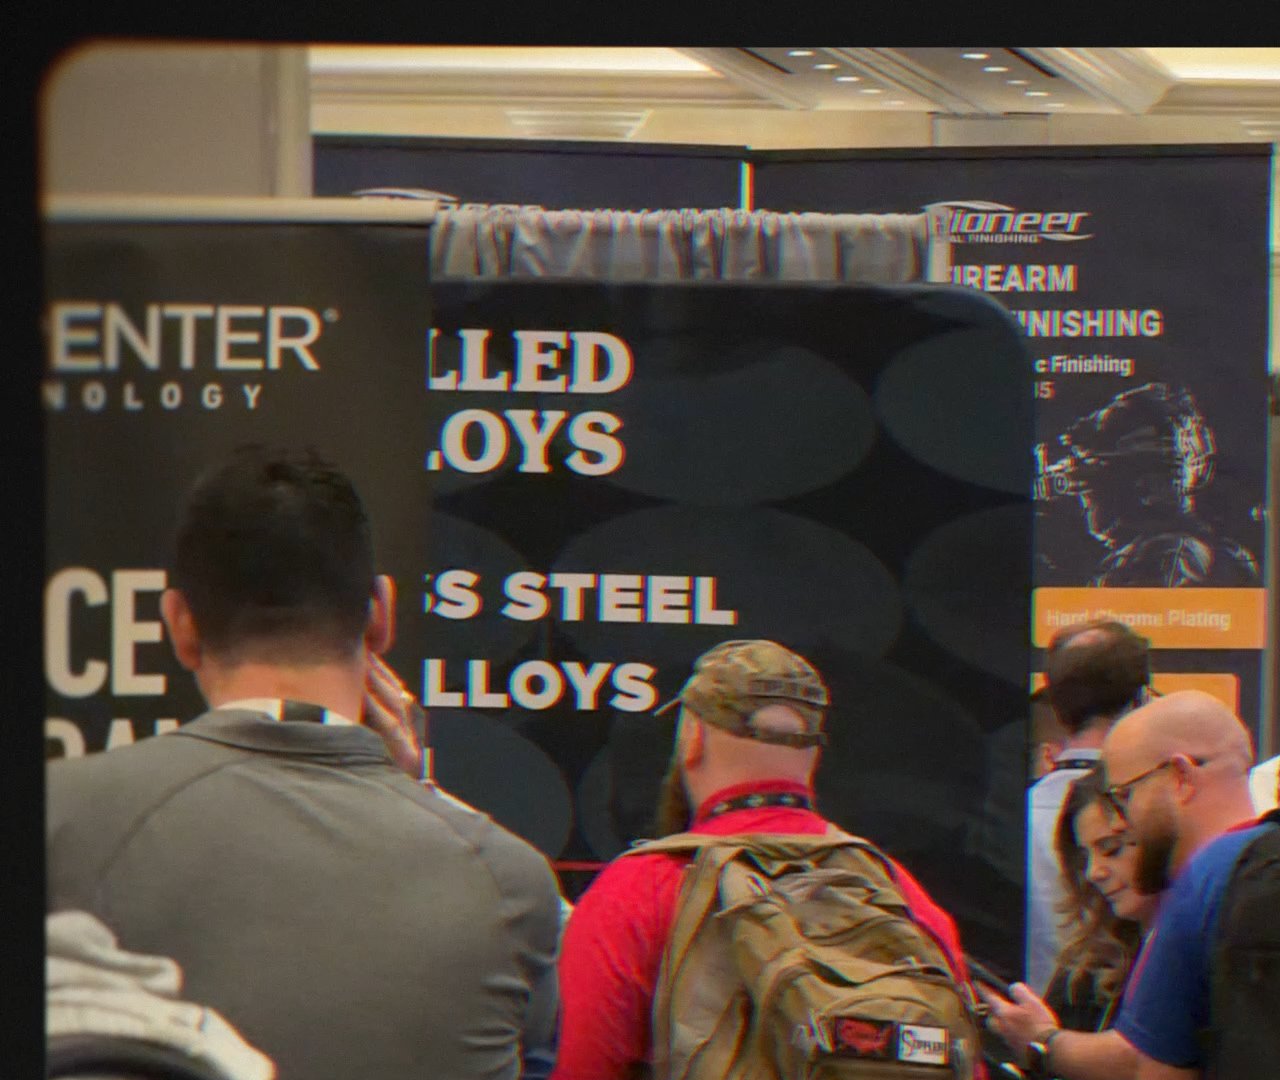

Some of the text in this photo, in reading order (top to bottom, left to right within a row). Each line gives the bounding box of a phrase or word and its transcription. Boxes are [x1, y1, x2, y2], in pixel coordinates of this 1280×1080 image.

[950, 209, 1091, 233] ioneer
[950, 264, 1078, 292] IREARM
[1050, 354, 1135, 377] Finishing
[426, 408, 627, 477] OYS
[423, 569, 739, 626] S STEEL
[1168, 608, 1233, 632] Plating
